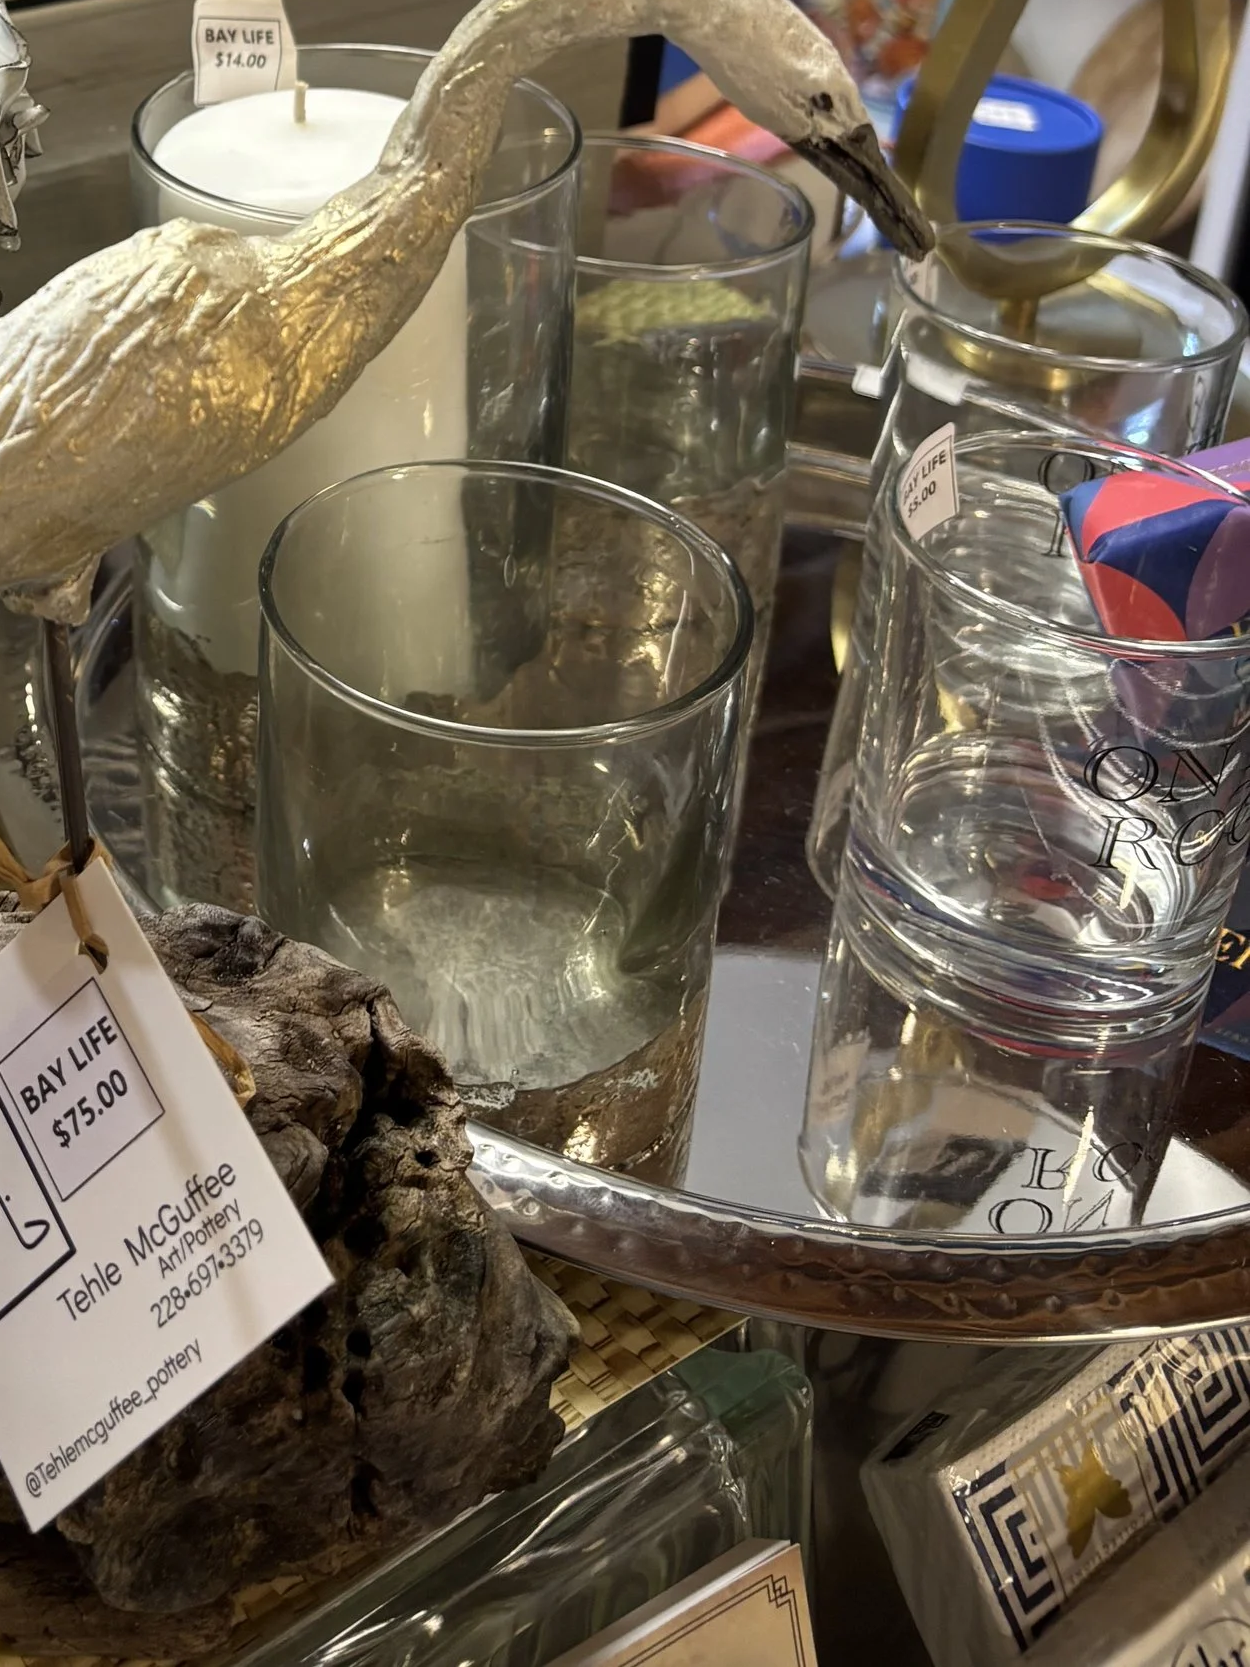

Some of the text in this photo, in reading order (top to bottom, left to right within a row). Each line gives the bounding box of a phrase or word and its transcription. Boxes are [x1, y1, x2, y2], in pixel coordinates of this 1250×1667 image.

[205, 28, 275, 45] BAY LIFE
[215, 52, 267, 69] $14.00
[922, 450, 947, 479] LIFE
[20, 1015, 118, 1115] BAY LIFE
[52, 1069, 128, 1148] $75.00
[56, 1163, 237, 1321] Tehle McGuffee
[158, 1198, 241, 1278] Art/Pottery
[25, 1338, 203, 1498] @Tehlemcguffee_pottery
